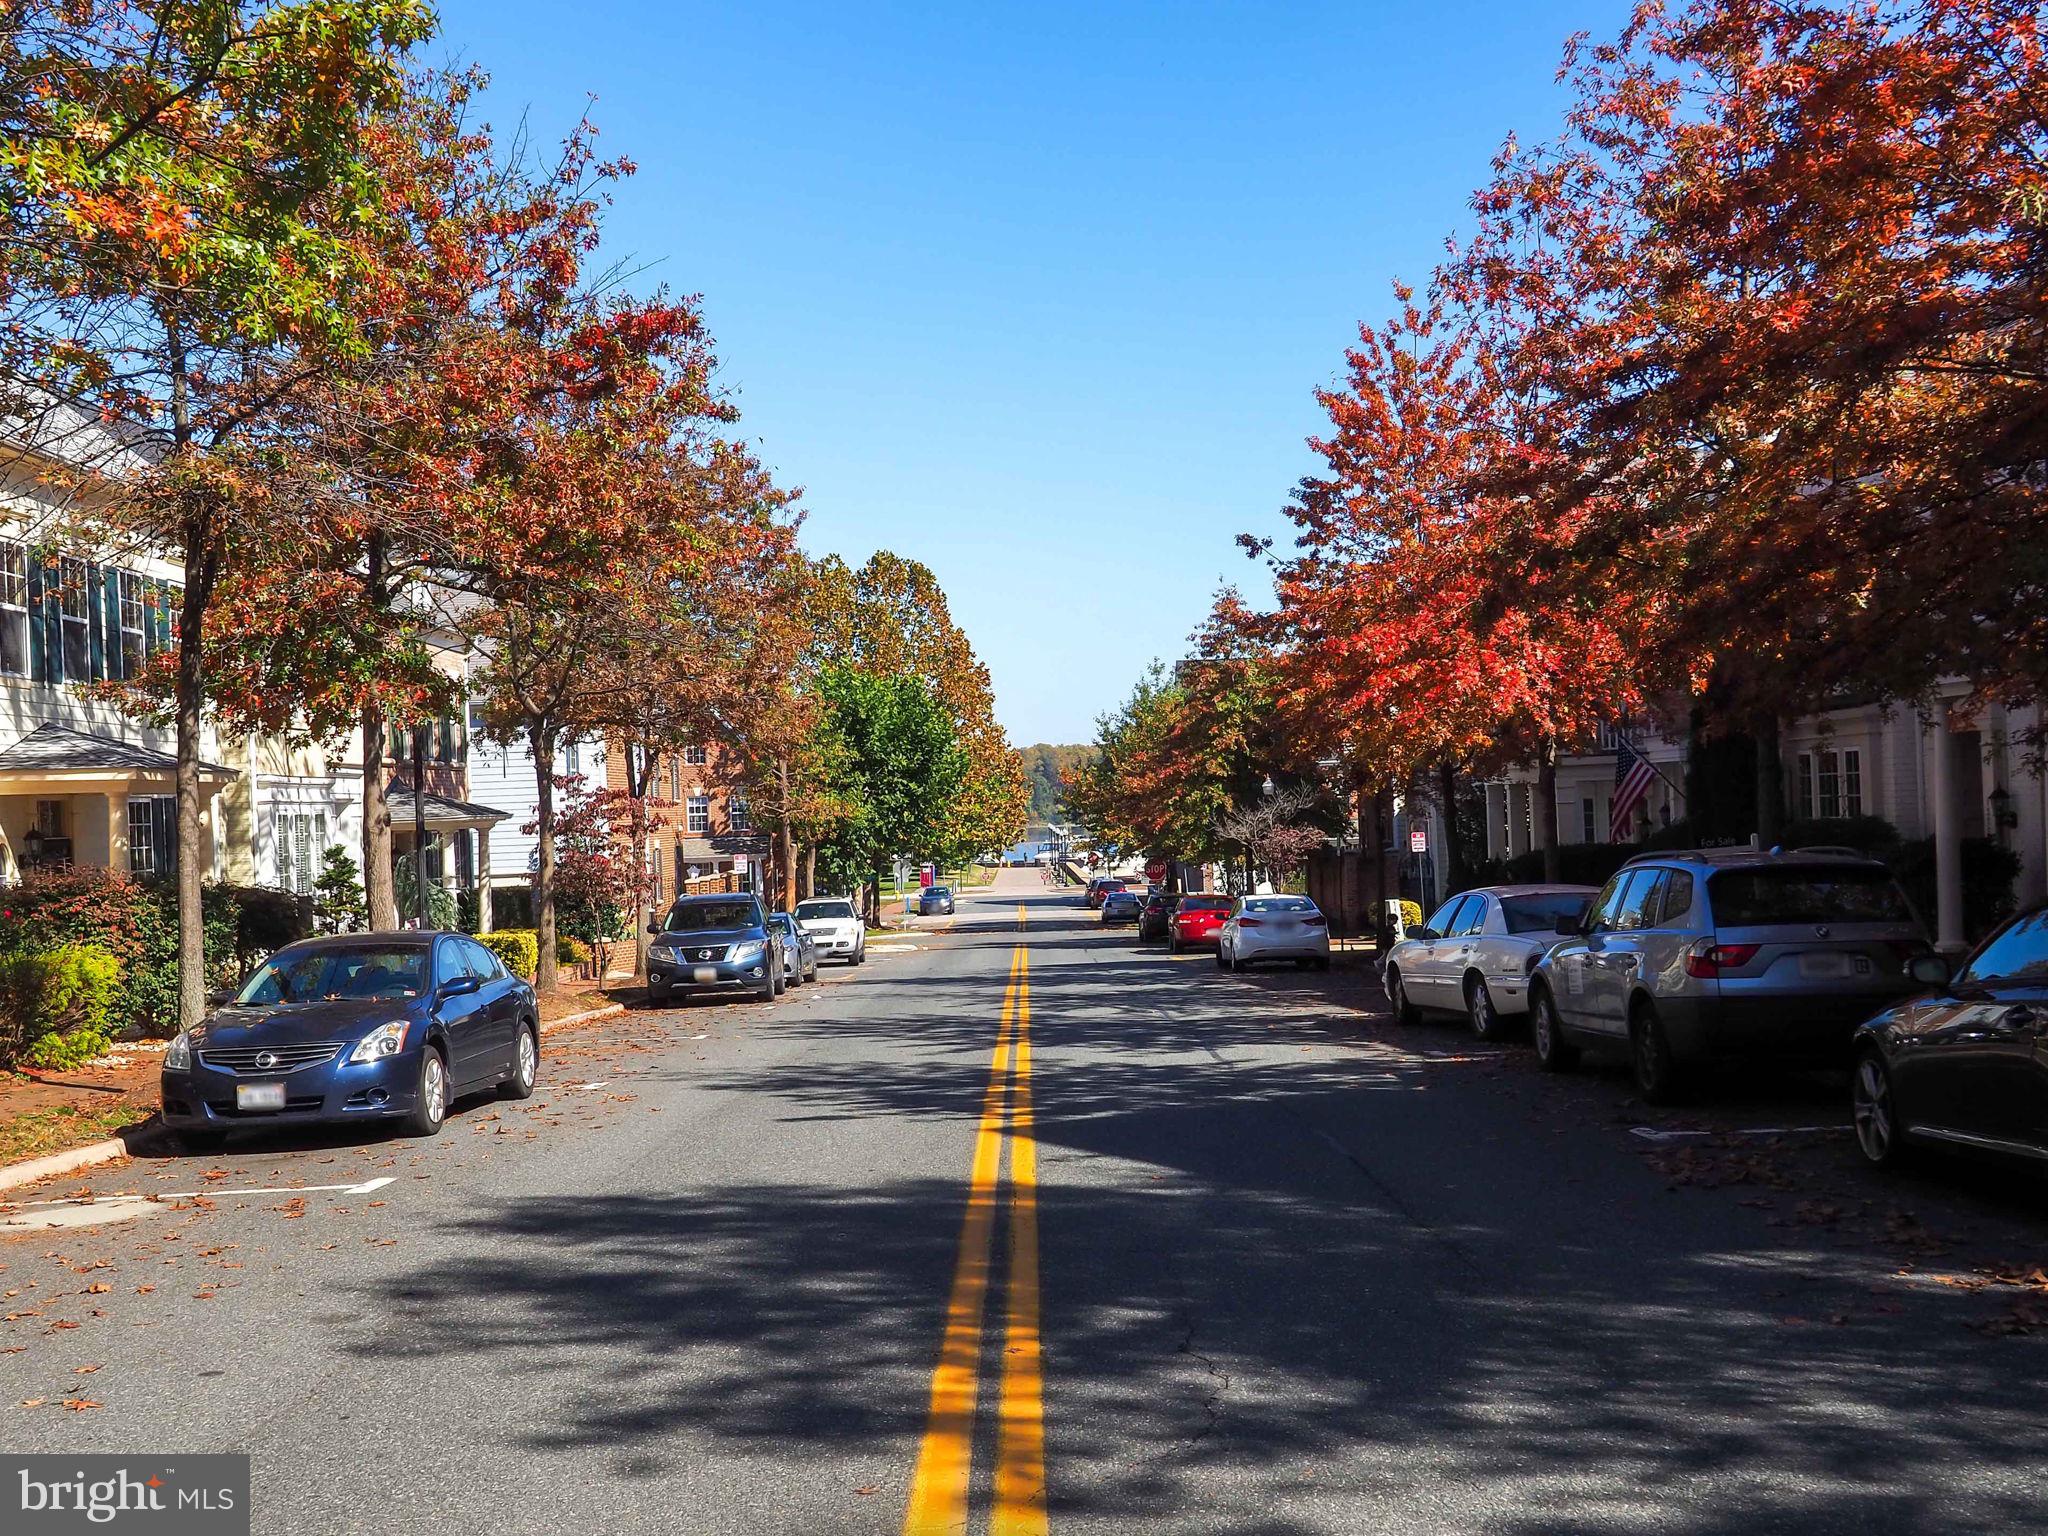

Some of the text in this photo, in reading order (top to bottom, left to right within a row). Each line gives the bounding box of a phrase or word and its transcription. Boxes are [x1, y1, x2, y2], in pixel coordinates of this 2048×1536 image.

[1701, 836, 1736, 847] For Sale
[1145, 864, 1165, 874] STOP
